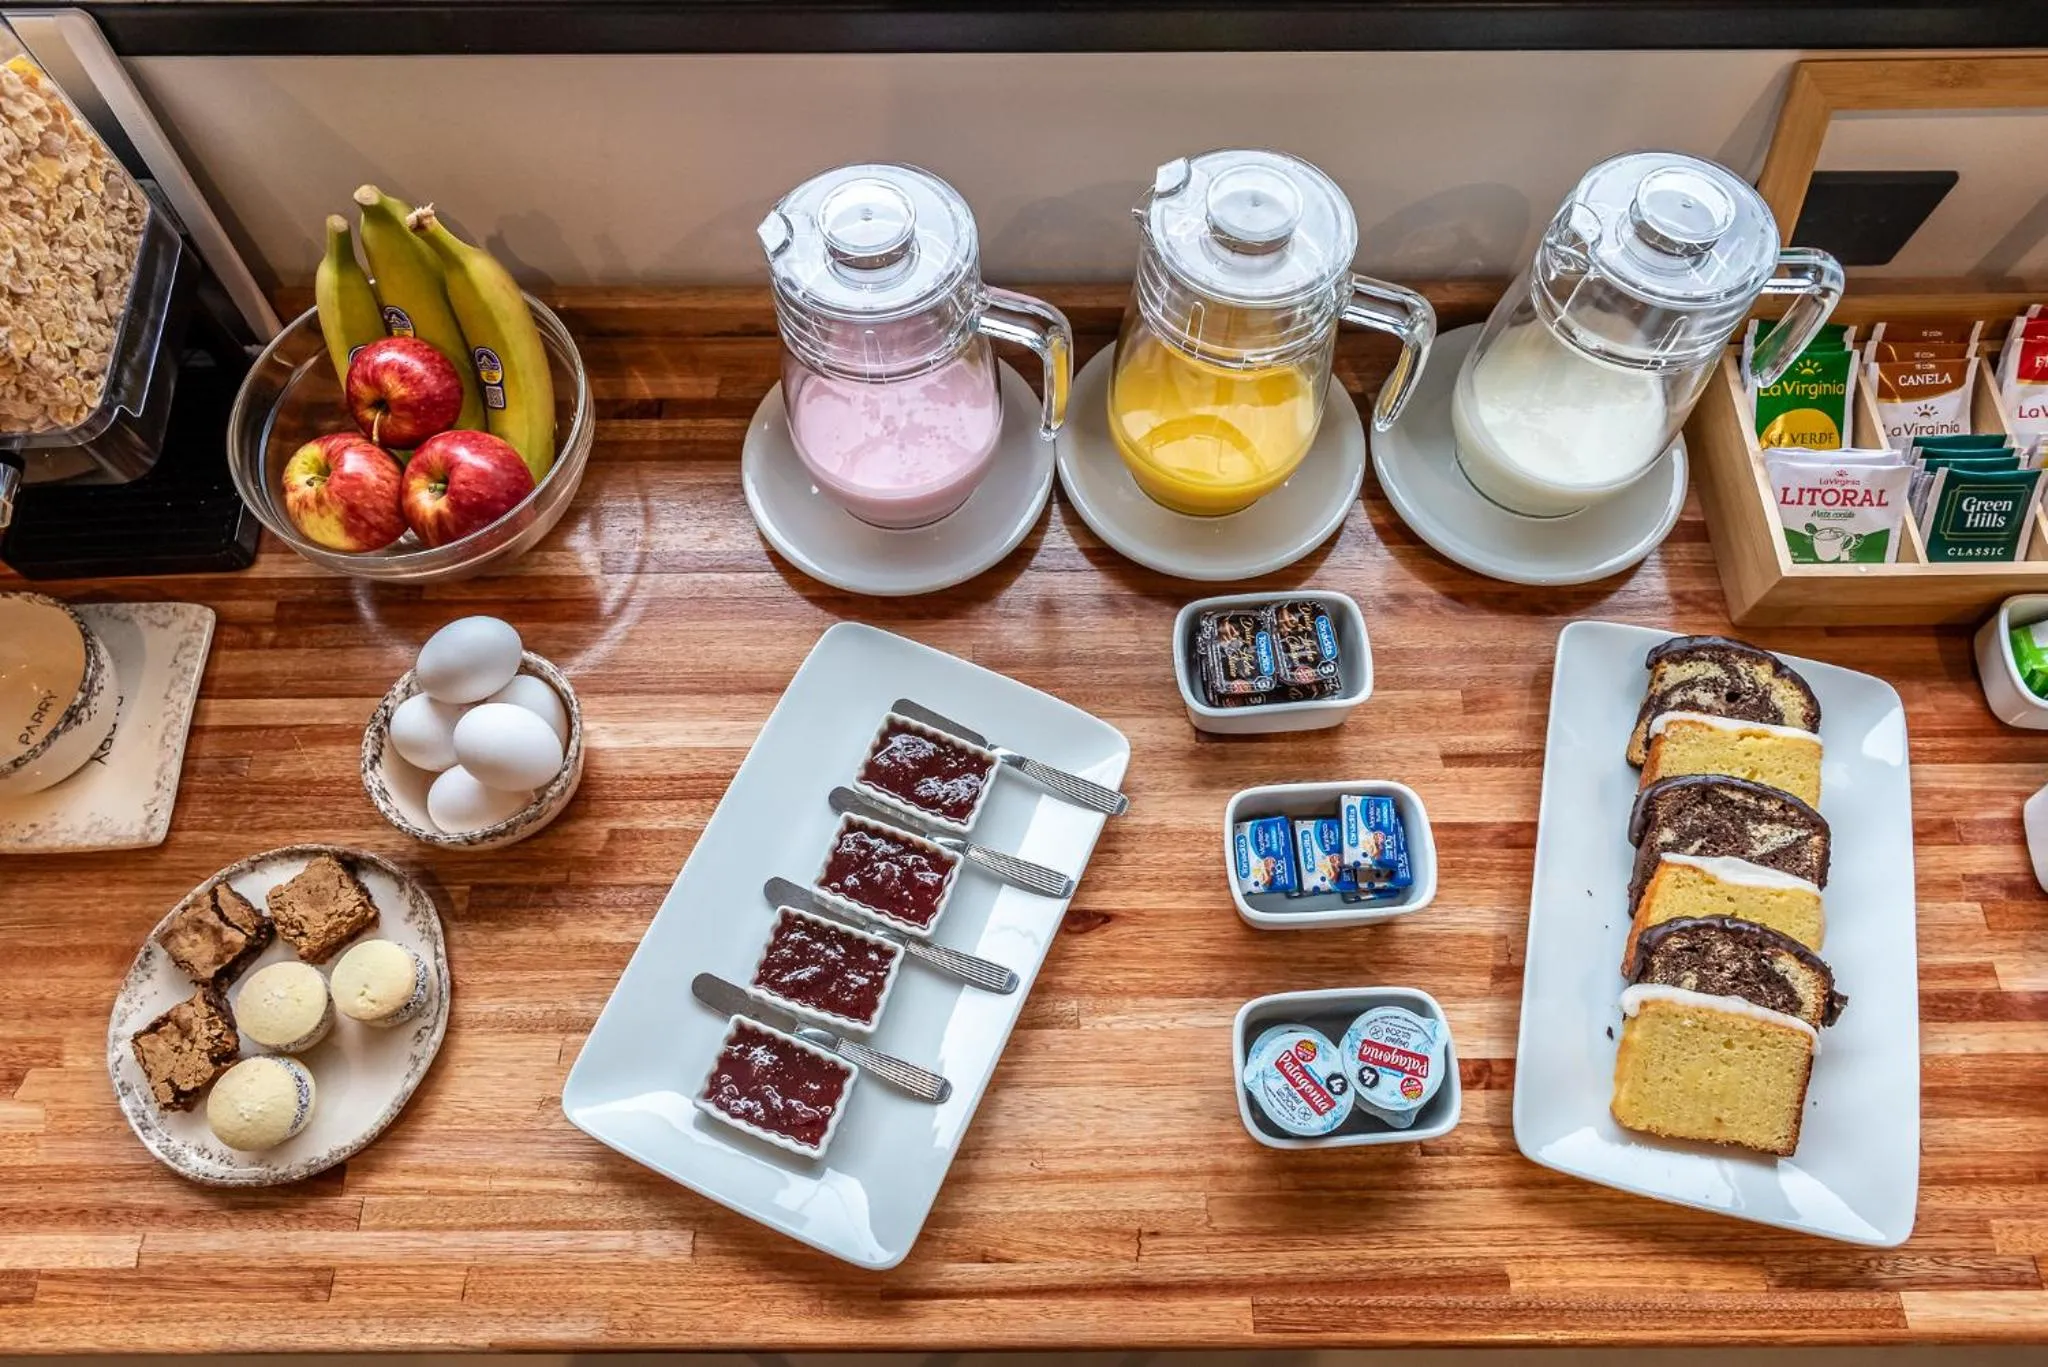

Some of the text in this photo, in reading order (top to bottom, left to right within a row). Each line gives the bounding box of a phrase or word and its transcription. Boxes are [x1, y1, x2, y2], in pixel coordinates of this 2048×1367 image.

[1898, 372, 1953, 387] CANELA
[1790, 431, 1836, 445] VERDE
[1780, 486, 1889, 508] LITORAL
[1961, 496, 2013, 512] Green
[1965, 512, 2007, 529] Hills
[1947, 547, 2005, 557] CLASSIC
[1318, 619, 1334, 656] Tonadita
[1348, 807, 1357, 845] Tonadita
[1361, 1043, 1429, 1077] Patagonia
[1277, 1052, 1332, 1114] Patagonia
[1361, 1067, 1376, 1084] 4
[1328, 1076, 1345, 1093] 4
